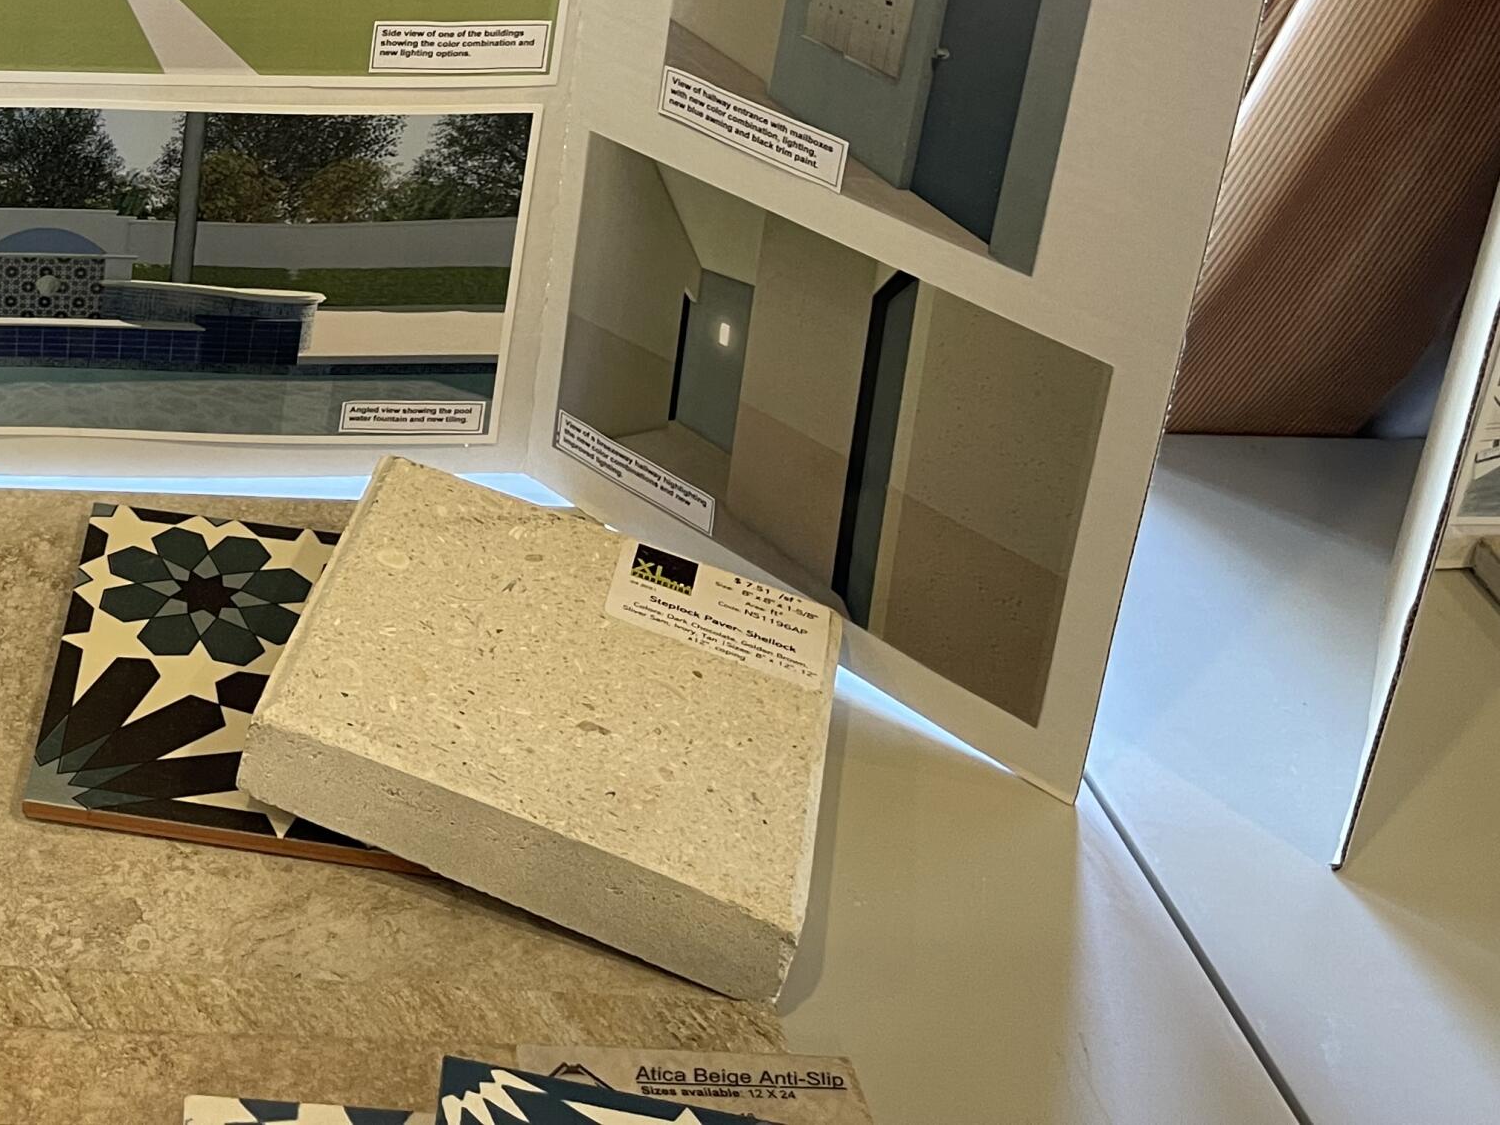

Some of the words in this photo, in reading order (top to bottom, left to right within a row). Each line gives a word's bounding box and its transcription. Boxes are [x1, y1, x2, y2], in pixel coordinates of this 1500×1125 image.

[381, 29, 402, 37] Side
[457, 30, 467, 38] of
[484, 29, 524, 38] buildings
[380, 39, 419, 48] showing
[437, 40, 460, 48] color
[400, 49, 434, 58] lighting
[435, 50, 471, 58] options.
[672, 77, 692, 90] View
[692, 87, 702, 95] of
[702, 90, 731, 110] hallway
[733, 105, 769, 125] entrance
[770, 121, 788, 134] with
[789, 130, 833, 153] mailboxes
[349, 406, 380, 414] Angled
[402, 407, 437, 415] showing
[453, 407, 473, 415] pool
[635, 1066, 686, 1082] Atica
[694, 1068, 751, 1086] Beige
[759, 1070, 844, 1088] Anti-Slip
[641, 1086, 678, 1096] Sizes
[681, 1087, 742, 1098] available:
[749, 1089, 765, 1099] 12
[768, 1090, 777, 1099] X
[780, 1089, 796, 1100] 24
